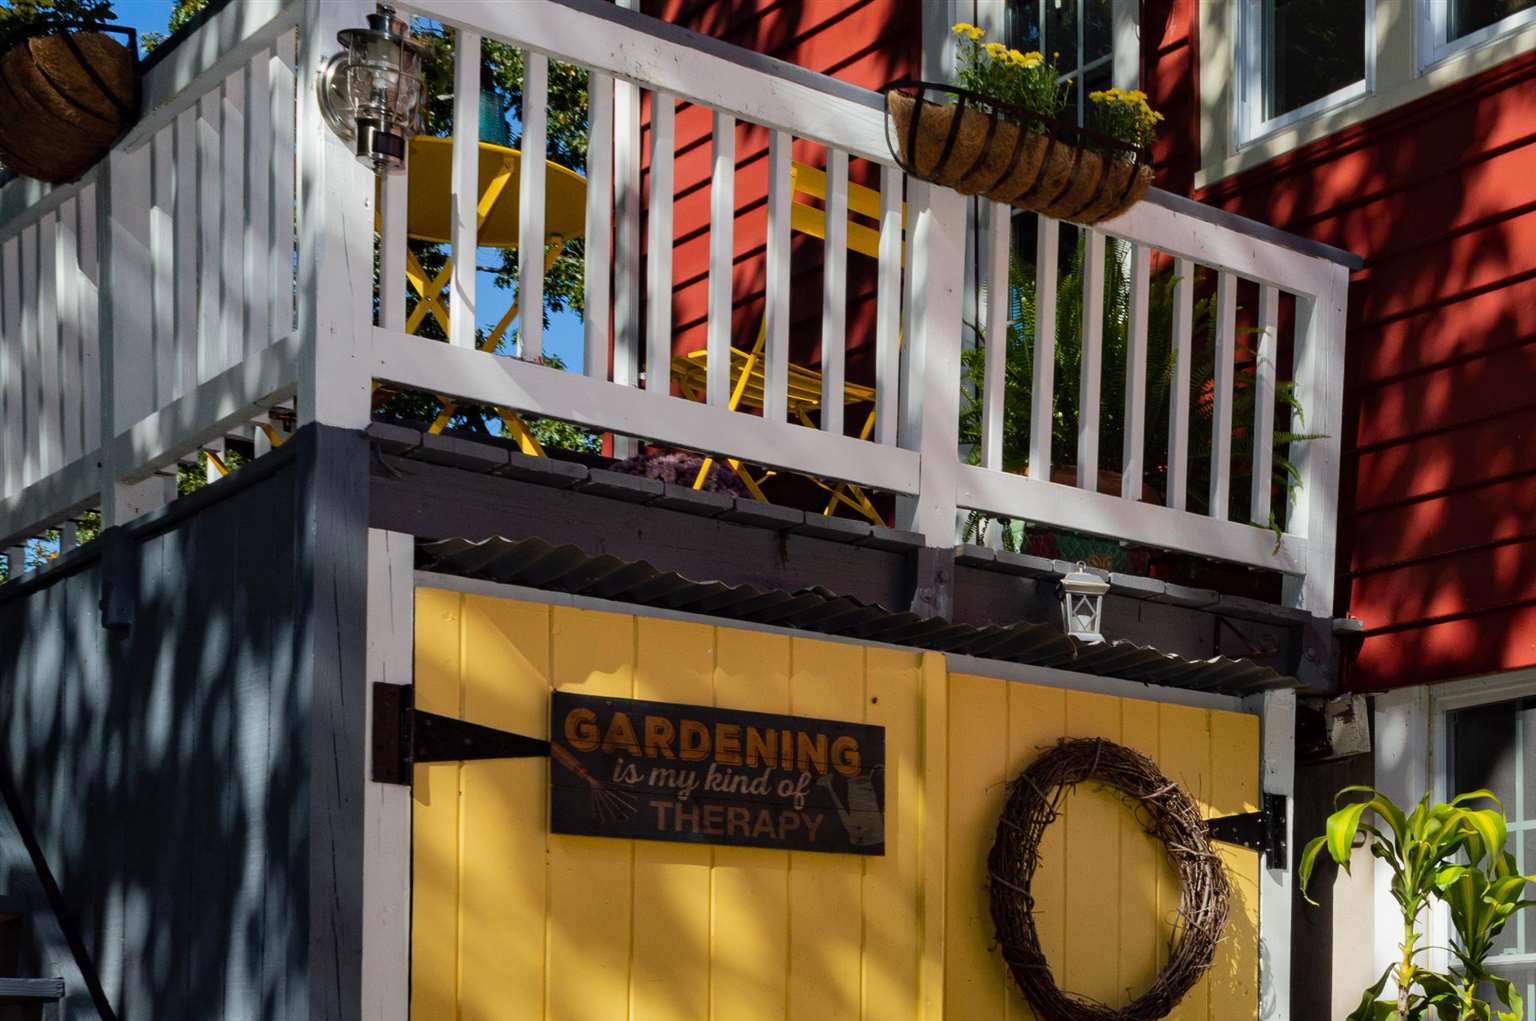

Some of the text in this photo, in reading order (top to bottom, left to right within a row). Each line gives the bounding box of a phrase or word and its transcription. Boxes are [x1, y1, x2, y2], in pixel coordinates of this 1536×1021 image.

[564, 707, 862, 777] GARDENING
[612, 758, 812, 810] is my kind of
[650, 801, 824, 843] THERAPY
